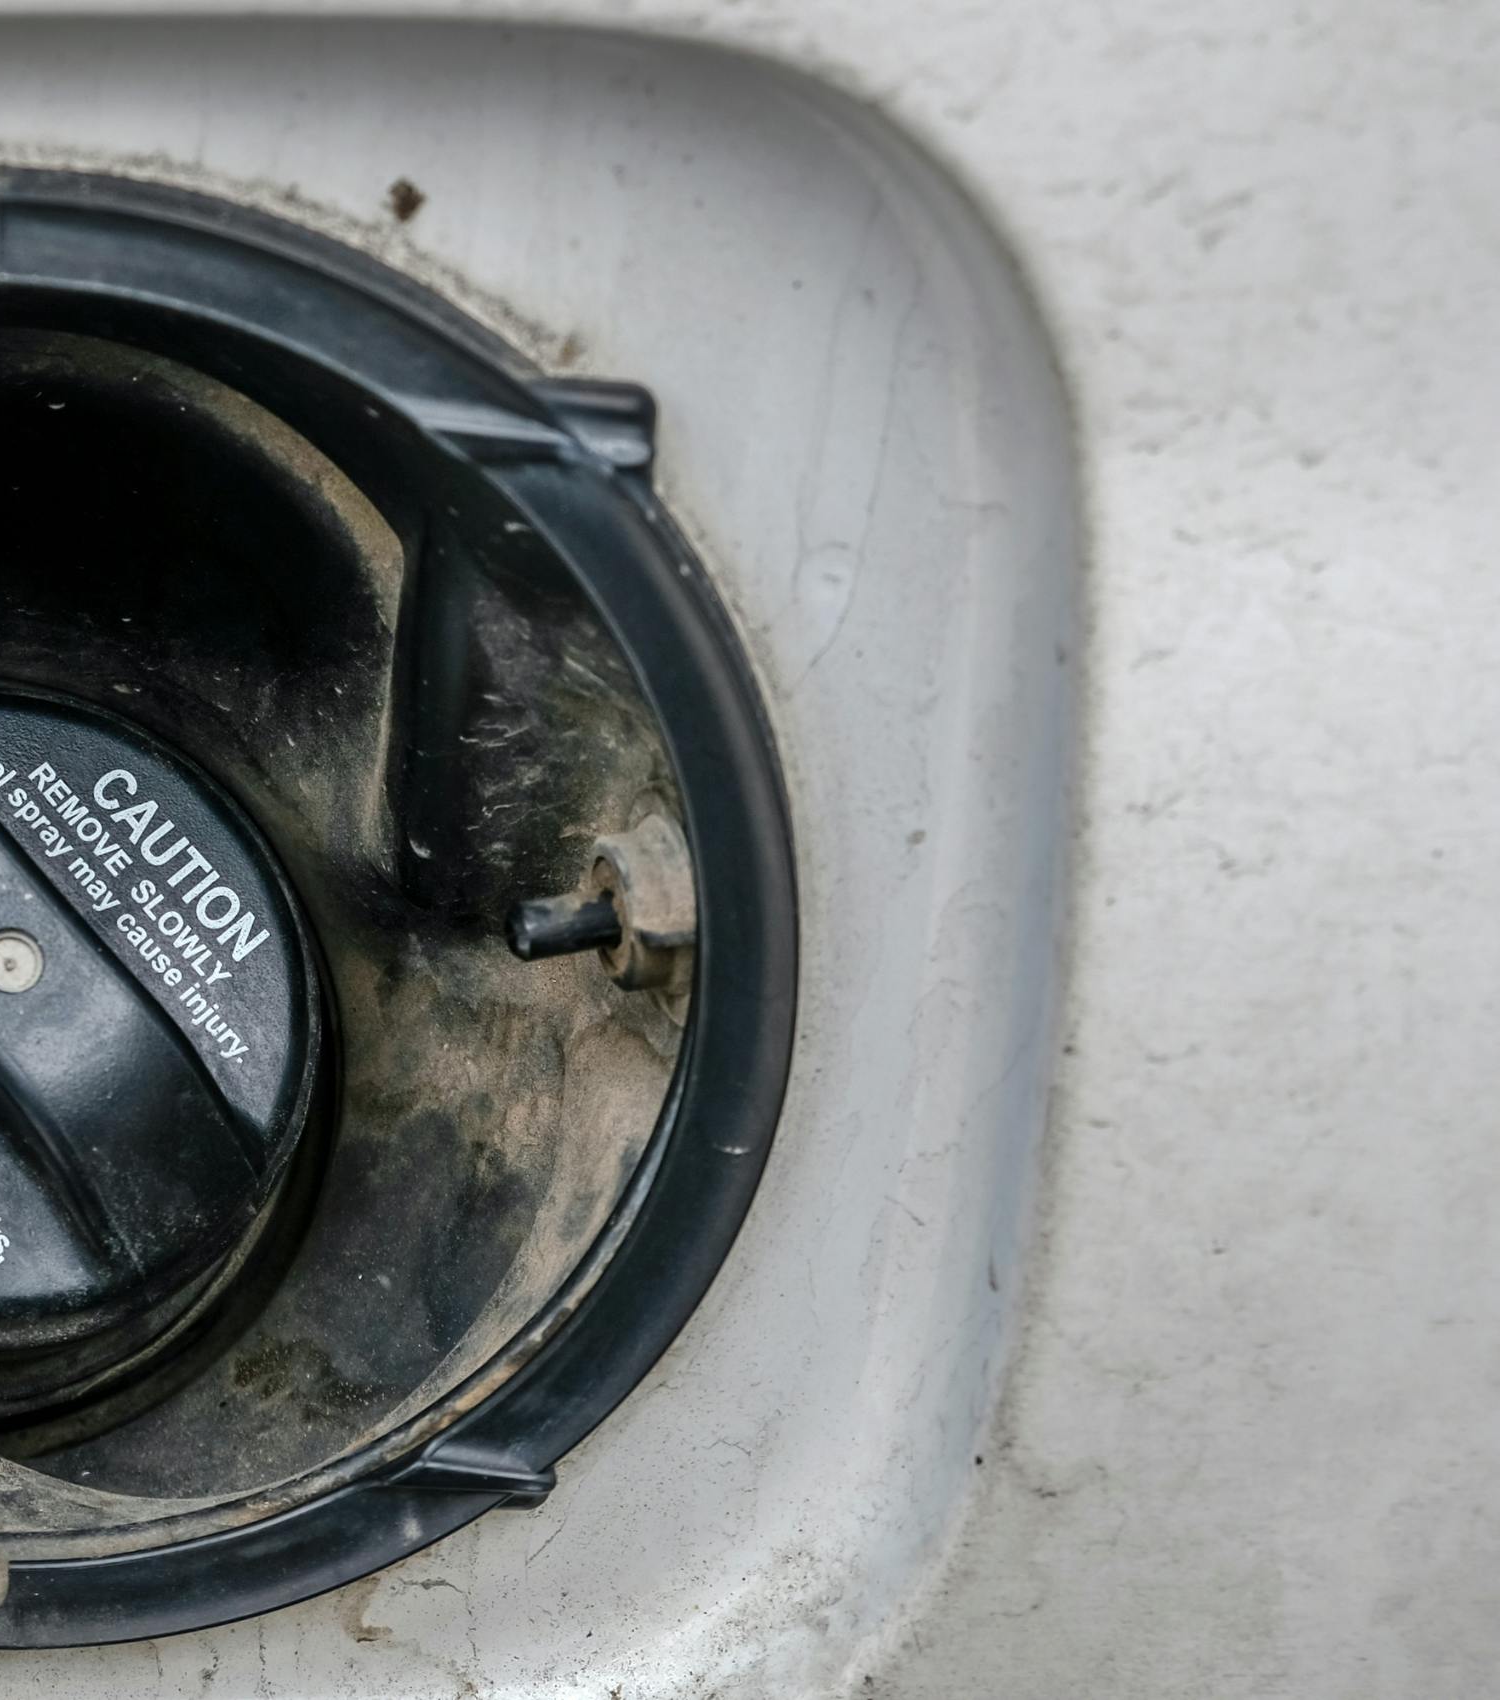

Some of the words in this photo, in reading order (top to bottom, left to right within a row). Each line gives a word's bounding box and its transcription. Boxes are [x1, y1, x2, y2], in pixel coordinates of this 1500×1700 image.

[8, 787, 74, 858] spray
[68, 856, 121, 913] may
[116, 913, 182, 986] cause
[179, 983, 249, 1064] injury.
[28, 762, 133, 877] REMOVE
[131, 879, 232, 987] SLOWLY
[93, 769, 270, 962] CAUTION
